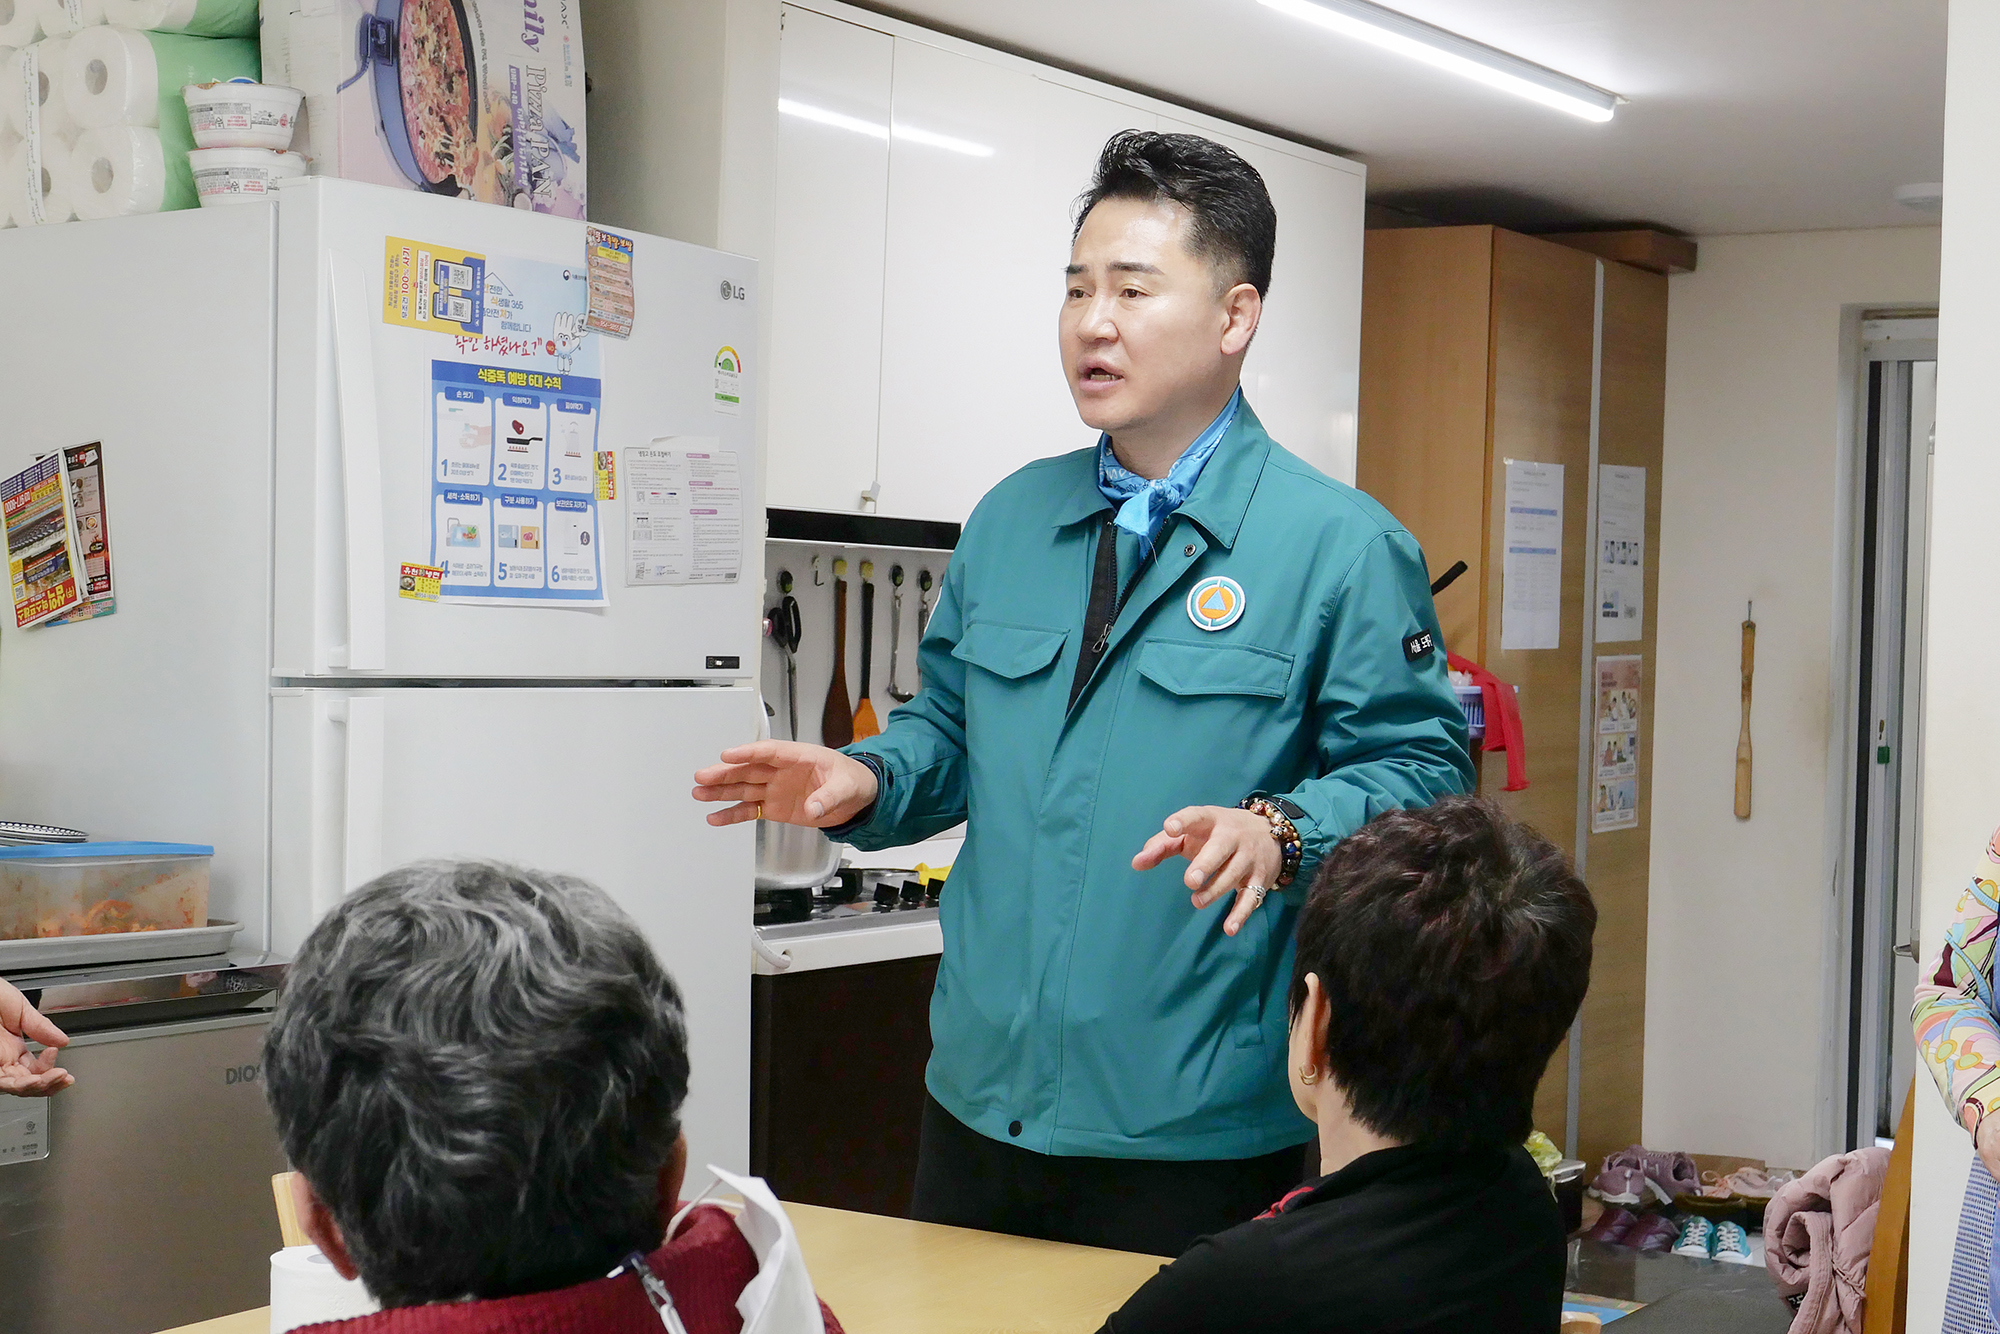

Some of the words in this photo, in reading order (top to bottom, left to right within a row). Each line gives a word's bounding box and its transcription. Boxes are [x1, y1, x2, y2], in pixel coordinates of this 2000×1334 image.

[525, 65, 547, 135] Pizza
[528, 138, 553, 199] PAN
[402, 246, 410, 266] 사기
[401, 267, 410, 294] 100%
[491, 296, 510, 308] 식생활
[511, 300, 524, 310] 365
[501, 320, 532, 332] 함께합니다
[478, 368, 506, 385] 식중독
[508, 371, 526, 386] 예방
[528, 374, 542, 388] 6대
[544, 375, 561, 390] 수칙
[441, 458, 448, 477] 1
[498, 463, 507, 481] 2
[552, 468, 561, 485] 3
[504, 496, 514, 504] 구분
[515, 496, 535, 506] 사용하기
[426, 570, 440, 579] 냉면
[440, 560, 450, 578] 4
[498, 562, 507, 580] 5
[551, 566, 560, 582] 6
[47, 584, 65, 611] 삼익
[18, 600, 48, 622] 익스프레스
